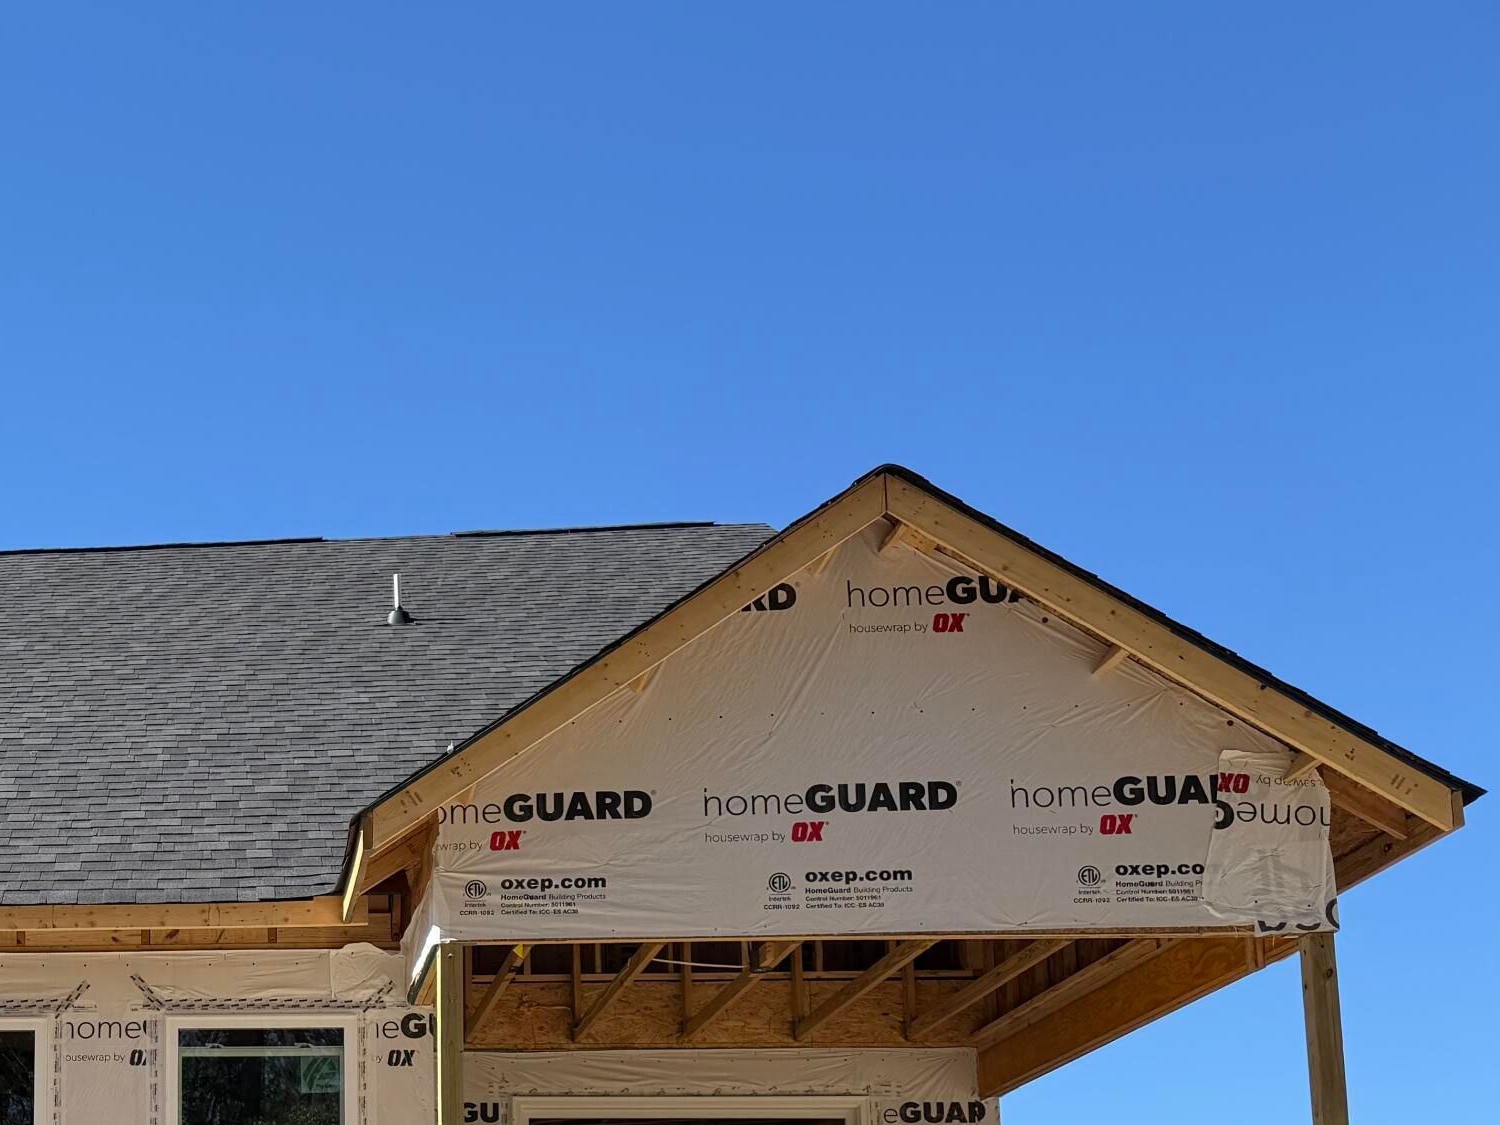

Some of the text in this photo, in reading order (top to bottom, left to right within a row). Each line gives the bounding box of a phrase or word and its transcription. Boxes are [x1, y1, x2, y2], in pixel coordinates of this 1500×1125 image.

[849, 613, 966, 634] housewrap by OX
[704, 781, 957, 816] homeGUARD
[1010, 775, 1218, 808] homeGUA
[705, 822, 825, 843] housewrap by OX
[1013, 814, 1134, 836] housewrap by OX
[470, 831, 523, 852] by OX
[805, 868, 912, 884] oxep.com
[1115, 863, 1204, 878] oxep.co
[501, 877, 606, 893] oxep.com
[854, 886, 881, 894] Building
[578, 892, 606, 900] Products
[66, 1052, 125, 1063] ousewrap by
[388, 1050, 415, 1066] OX
